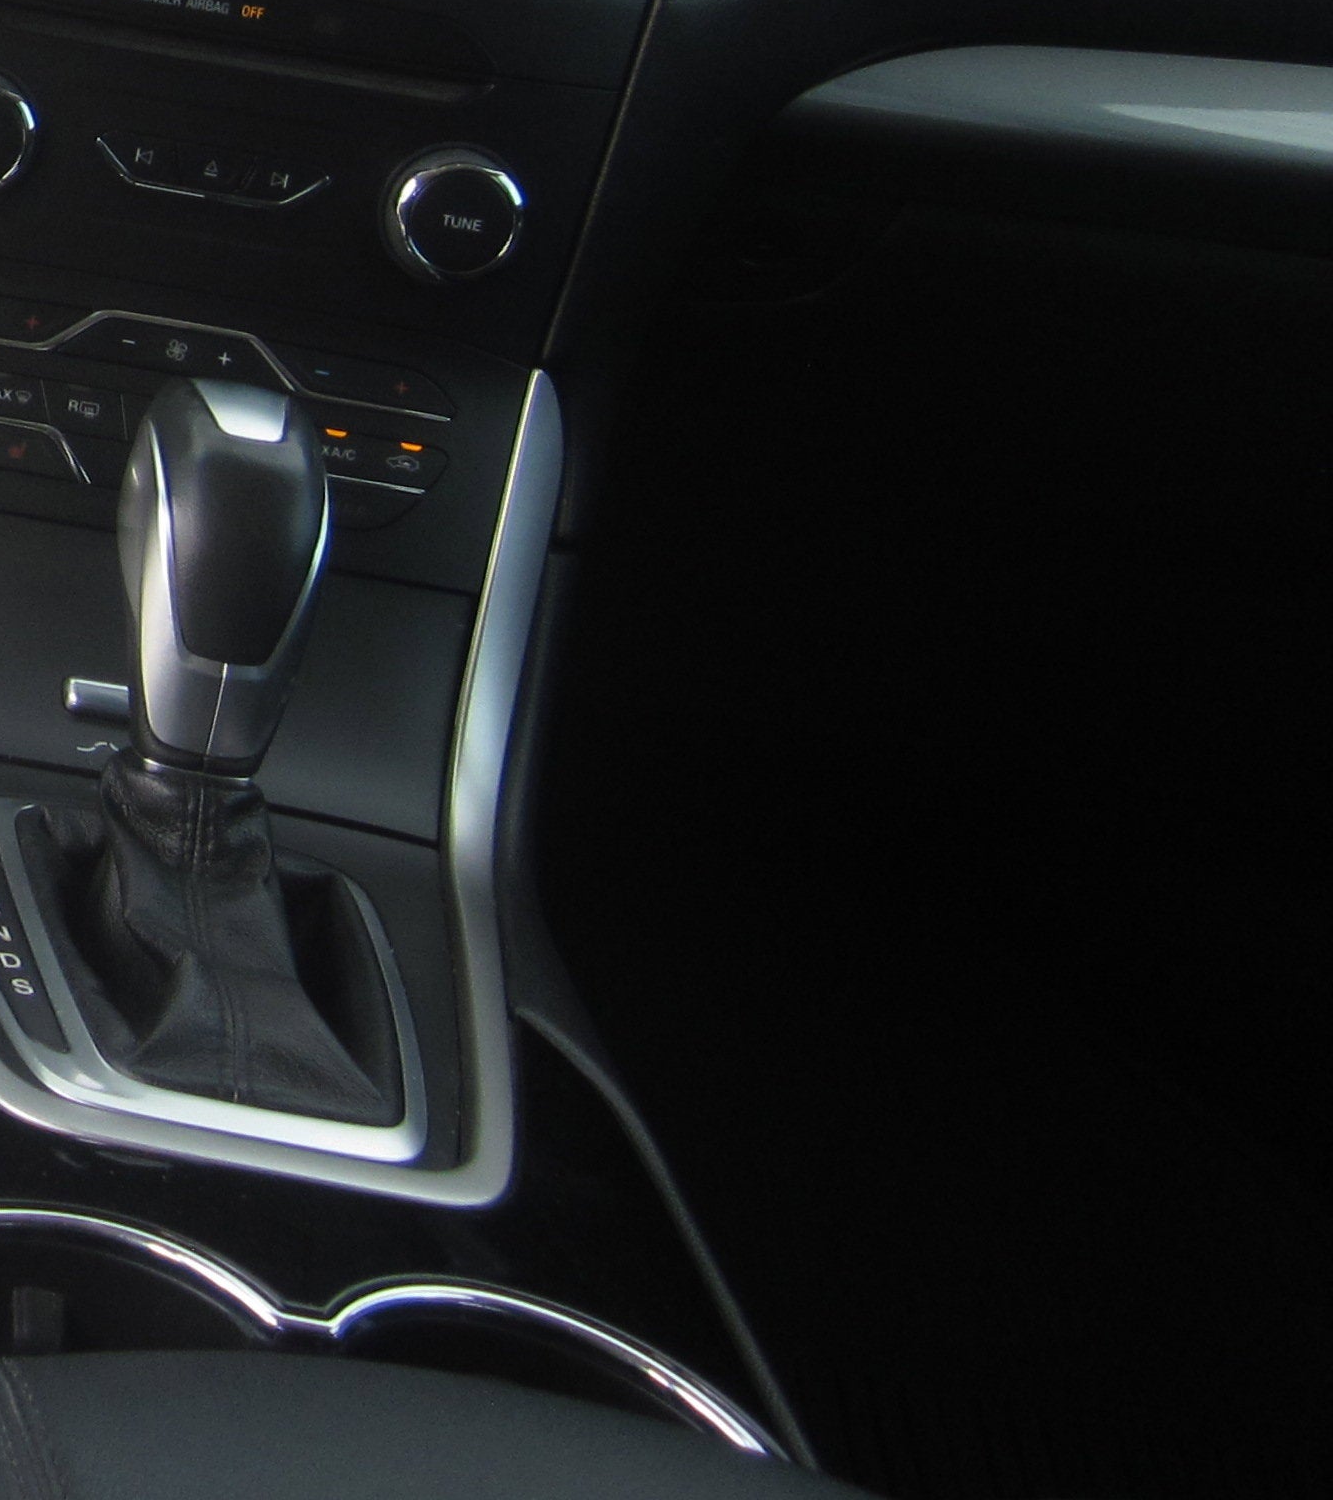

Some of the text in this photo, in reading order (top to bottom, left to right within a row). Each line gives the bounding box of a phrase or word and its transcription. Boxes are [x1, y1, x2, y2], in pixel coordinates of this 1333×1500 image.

[240, 4, 267, 20] OFF
[443, 213, 484, 233] TUNE
[10, 977, 35, 996] S
